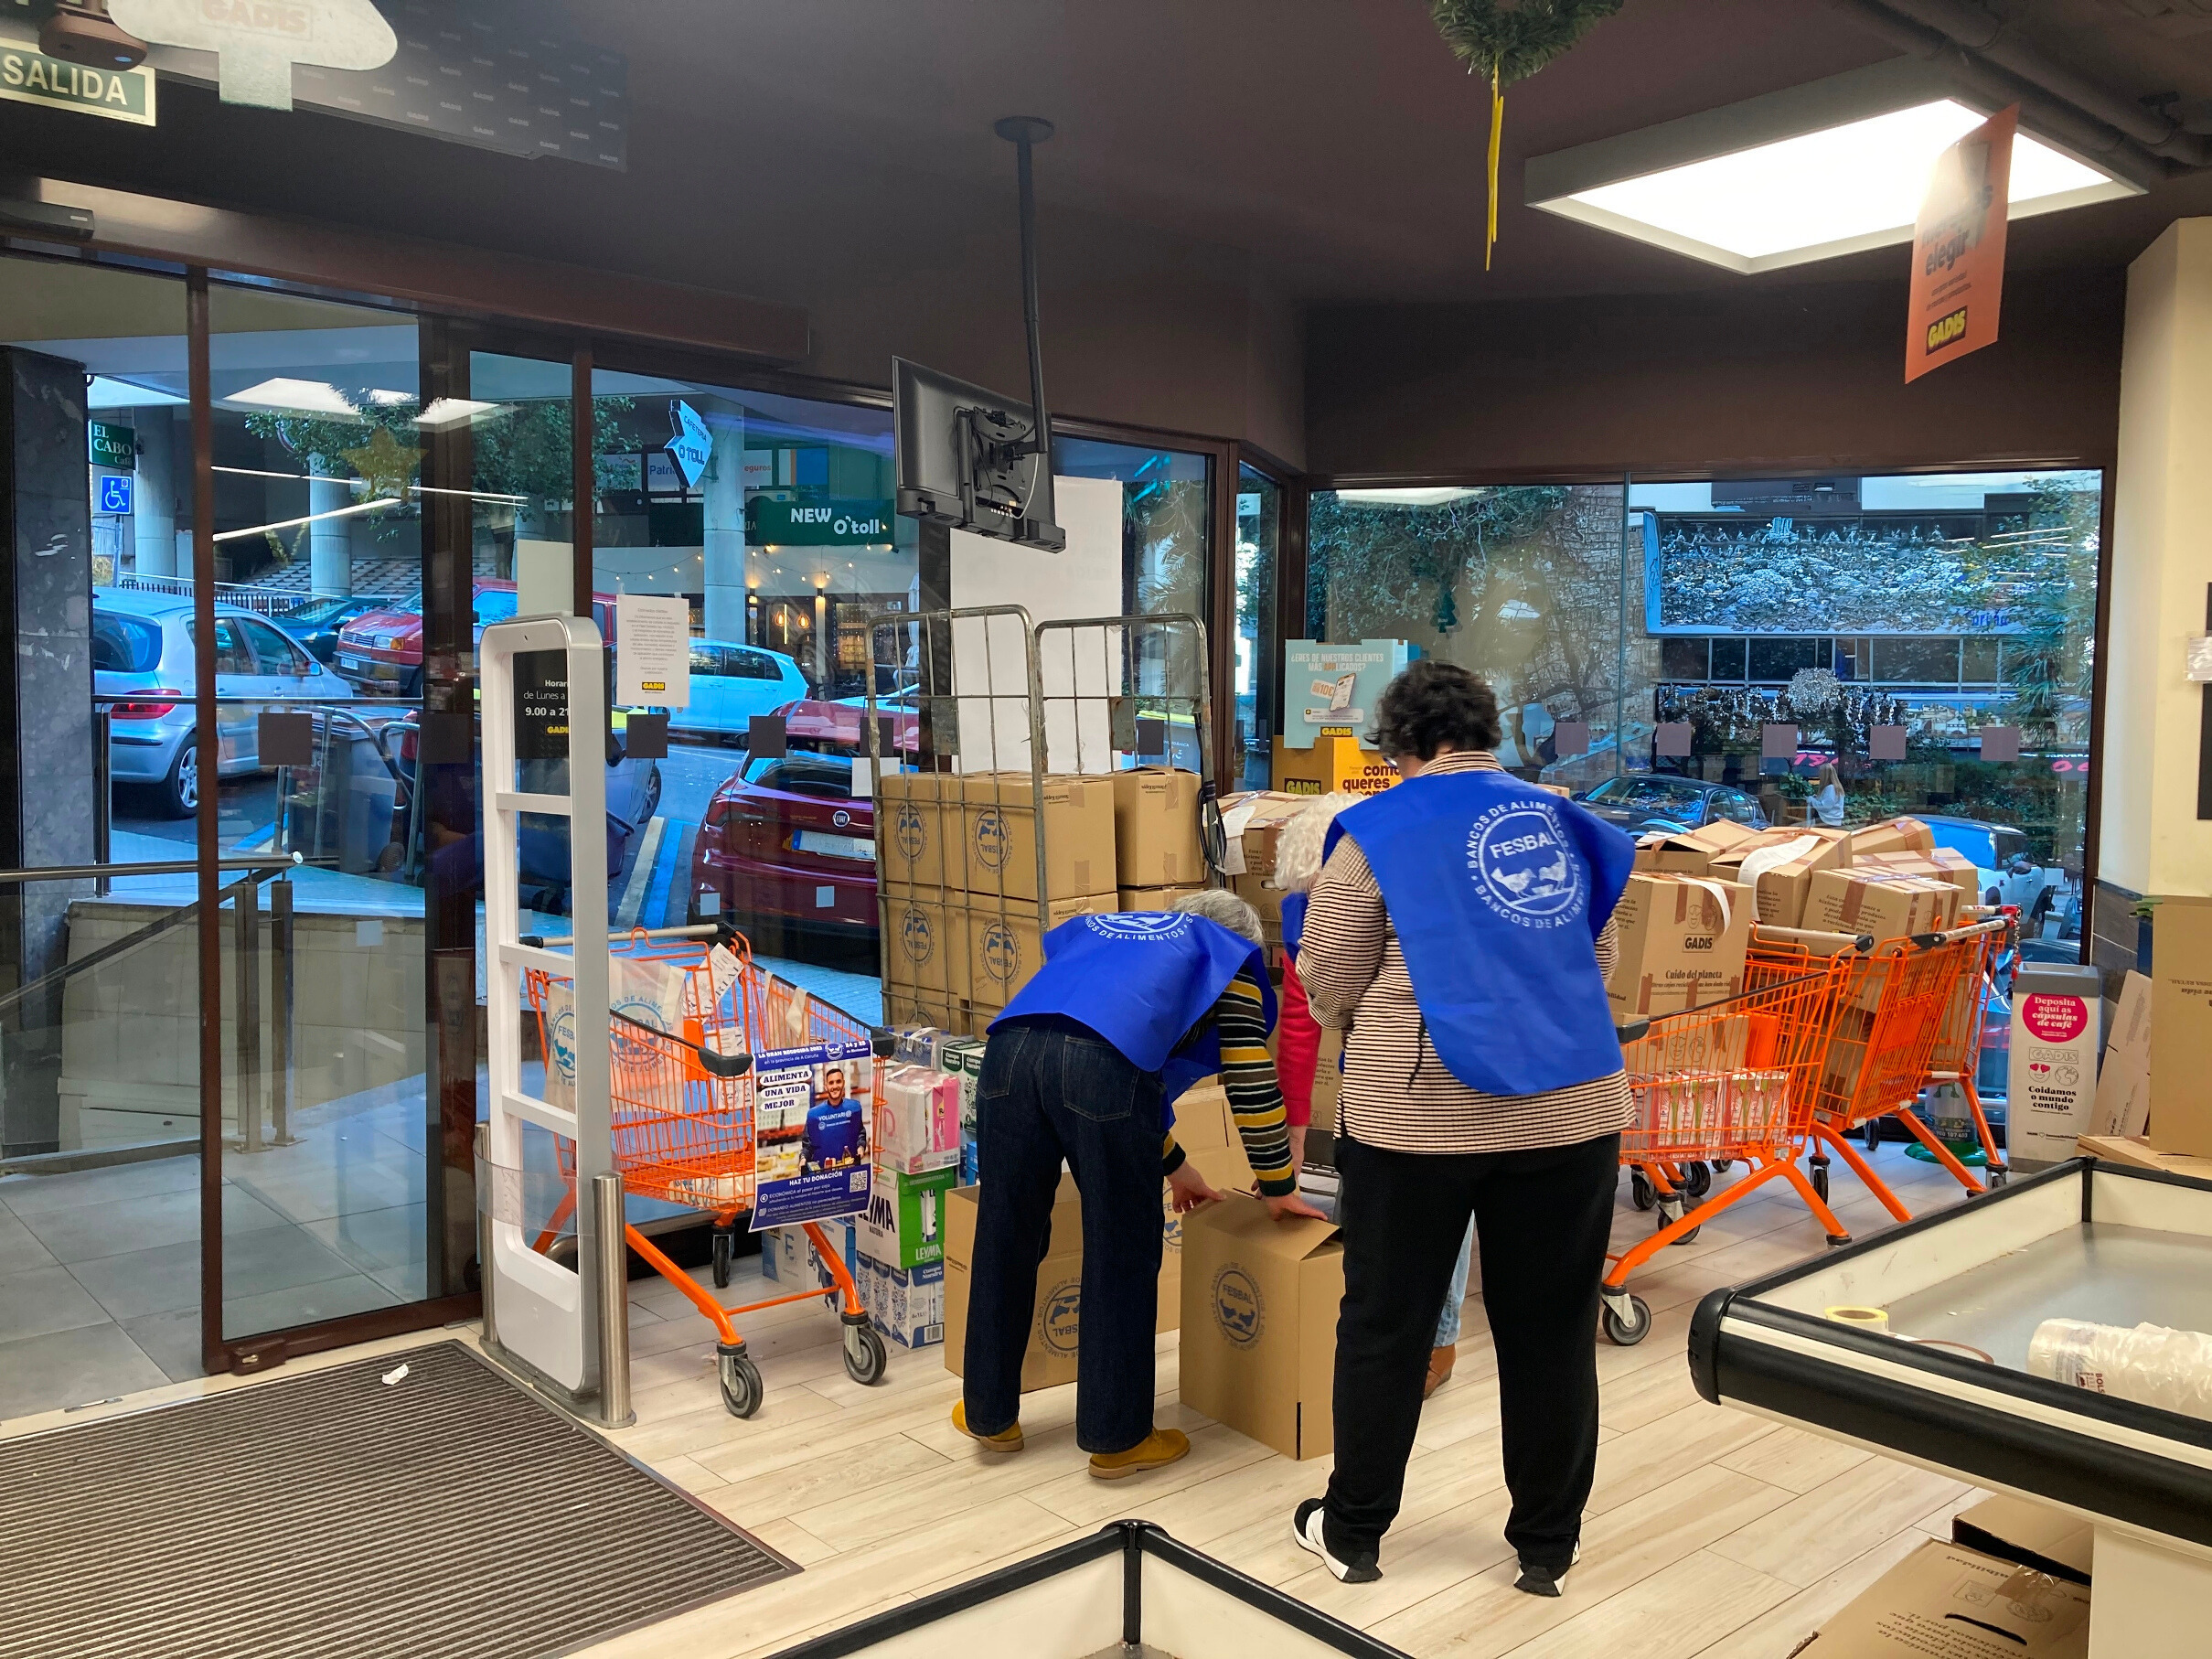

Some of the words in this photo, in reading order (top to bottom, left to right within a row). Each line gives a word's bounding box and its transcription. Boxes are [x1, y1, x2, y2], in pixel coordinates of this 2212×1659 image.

[202, 1, 306, 33] GADIS
[2, 55, 128, 106] SALIDA
[1928, 309, 1966, 349] GADIS
[93, 424, 110, 438] EL
[684, 415, 707, 442] CAFETERIA
[93, 438, 133, 455] CABO
[686, 448, 705, 466] TOLL
[743, 464, 772, 473] eguros
[790, 508, 831, 523] NEW
[1290, 653, 1310, 662] ¿ERES
[1311, 653, 1320, 662] DE
[1321, 653, 1353, 662] NUESTROS
[1354, 653, 1384, 662] CLIENTES
[523, 690, 534, 700] de
[536, 690, 560, 700] Lunes
[525, 707, 547, 716] 9.00
[1321, 727, 1352, 737] GADIS
[1286, 780, 1320, 795] GADIS
[1341, 777, 1391, 794] queres
[836, 815, 847, 823] FIAT
[1466, 815, 1491, 869] BANCOS
[1488, 804, 1509, 817] DE
[1489, 832, 1558, 859] FESBAL
[1474, 884, 1531, 927] BANCOS
[1534, 918, 1553, 928] DE
[1098, 929, 1114, 940] DE
[1115, 927, 1186, 941] ALIMENTOS
[1684, 937, 1714, 950] GADIS
[1665, 969, 1686, 979] Cuido
[1686, 969, 1697, 979] del
[1697, 969, 1723, 981] planeta
[2034, 996, 2077, 1007] Deposita
[2037, 1004, 2059, 1014] aquí
[2032, 1011, 2078, 1022] cápsulas
[2036, 1019, 2050, 1028] de
[2050, 1021, 2073, 1030] café
[2031, 1050, 2078, 1062] GADIS
[763, 1070, 809, 1084] ALIMENTA
[764, 1089, 784, 1097] UNA
[785, 1085, 807, 1095] VIDA
[2028, 1086, 2077, 1097] Coidamos
[764, 1099, 795, 1109] MEJOR
[2037, 1095, 2074, 1104] mundo
[2032, 1101, 2069, 1111] contigo
[789, 1178, 802, 1186] HAZ
[811, 1171, 843, 1183] DONACIÓN
[769, 1189, 796, 1199] ECONÓMICA
[869, 1226, 884, 1238] NATURA
[915, 1243, 942, 1261] LEYMA
[922, 1266, 942, 1275] Campo
[922, 1270, 943, 1279] Nuestro
[1888, 1611, 1915, 1624] que
[1916, 1622, 1950, 1639] para
[1922, 1619, 1949, 1631] por
[1875, 1621, 1946, 1652] productos
